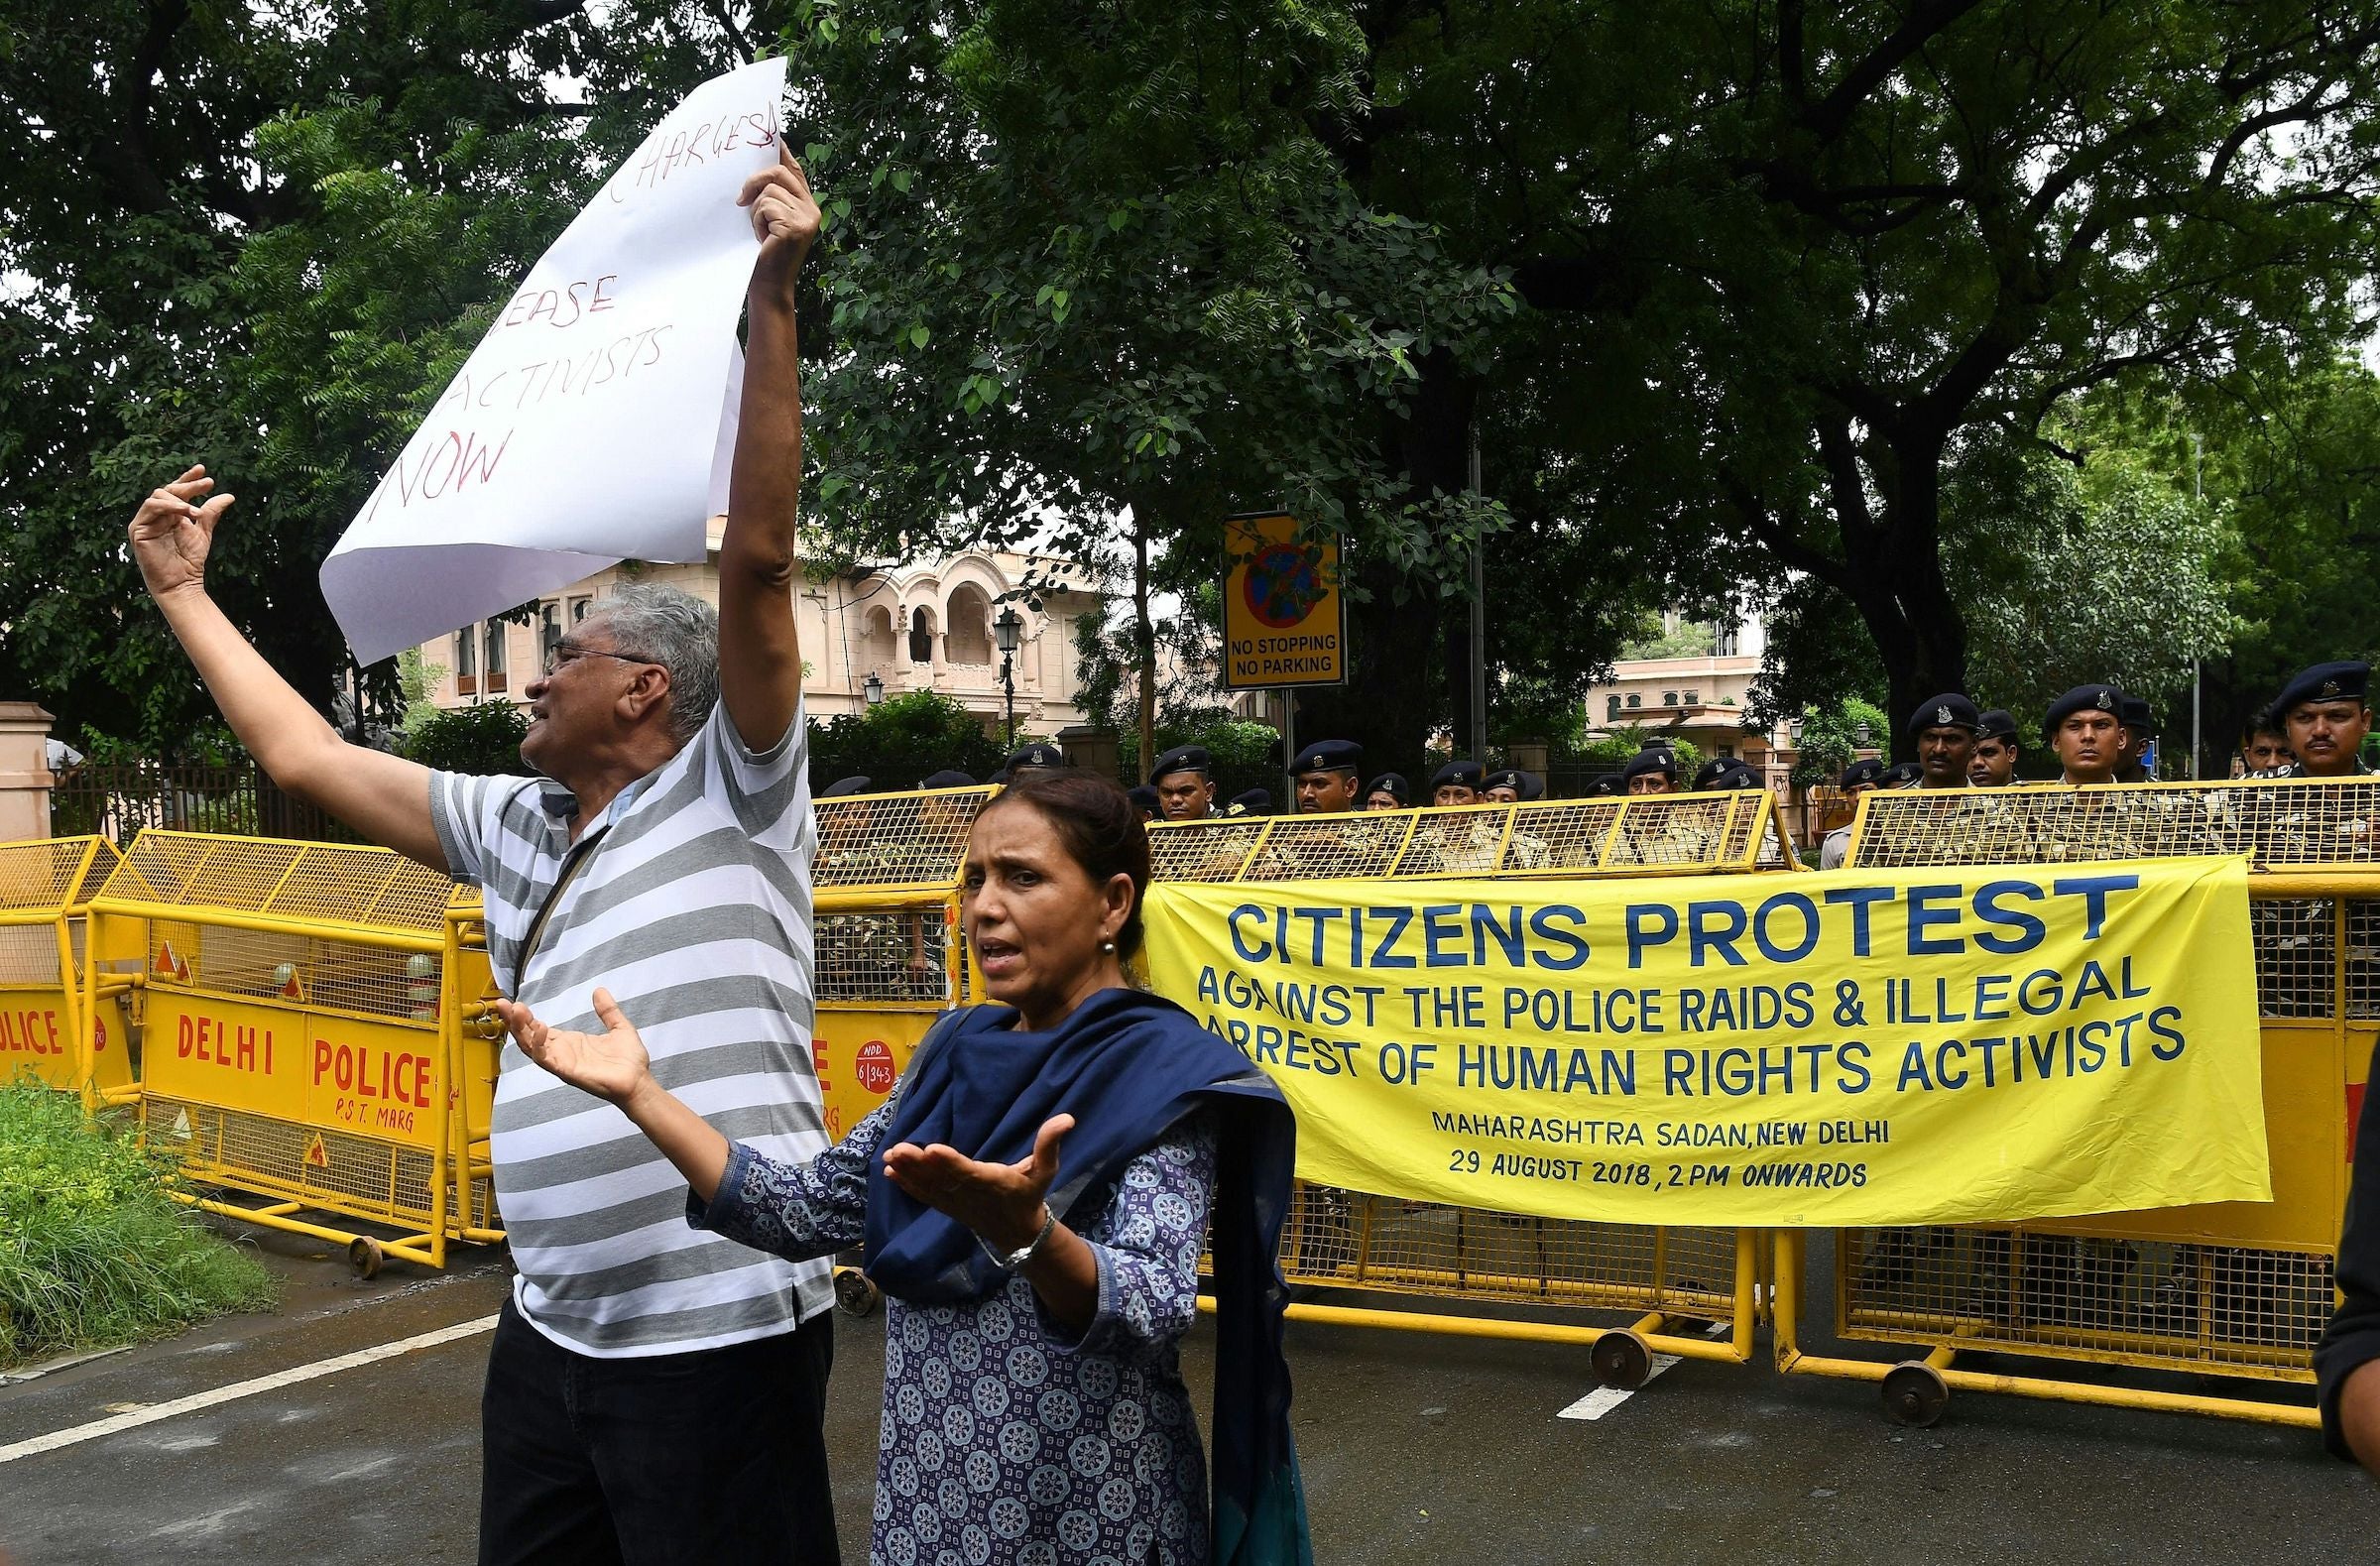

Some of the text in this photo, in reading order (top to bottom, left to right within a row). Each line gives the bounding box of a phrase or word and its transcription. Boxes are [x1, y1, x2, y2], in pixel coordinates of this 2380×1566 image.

[367, 427, 514, 524] NOW
[1232, 635, 1336, 656] NO STOPPING
[1237, 656, 1332, 675] NO PARKING
[1228, 875, 2139, 970] CITIZENS PROTEST
[1198, 955, 2151, 1033] AGAINST THE POLICE RAIDS & ILLEGAL
[178, 1015, 430, 1108] DELHI POLICE
[1379, 1043, 1437, 1085] OF
[1458, 1044, 1636, 1096] HUMAN
[1665, 1041, 1871, 1096] RIGHTS
[1897, 1006, 2186, 1091] ACTIVISTS
[376, 1107, 414, 1134] MARG
[1432, 1111, 1644, 1146] MAHARASHTRA
[1819, 1120, 1889, 1144] DELHI
[1449, 1149, 1481, 1173] 29
[1491, 1153, 1583, 1181] AUGUST
[1742, 1163, 1867, 1189] ONWARDS
